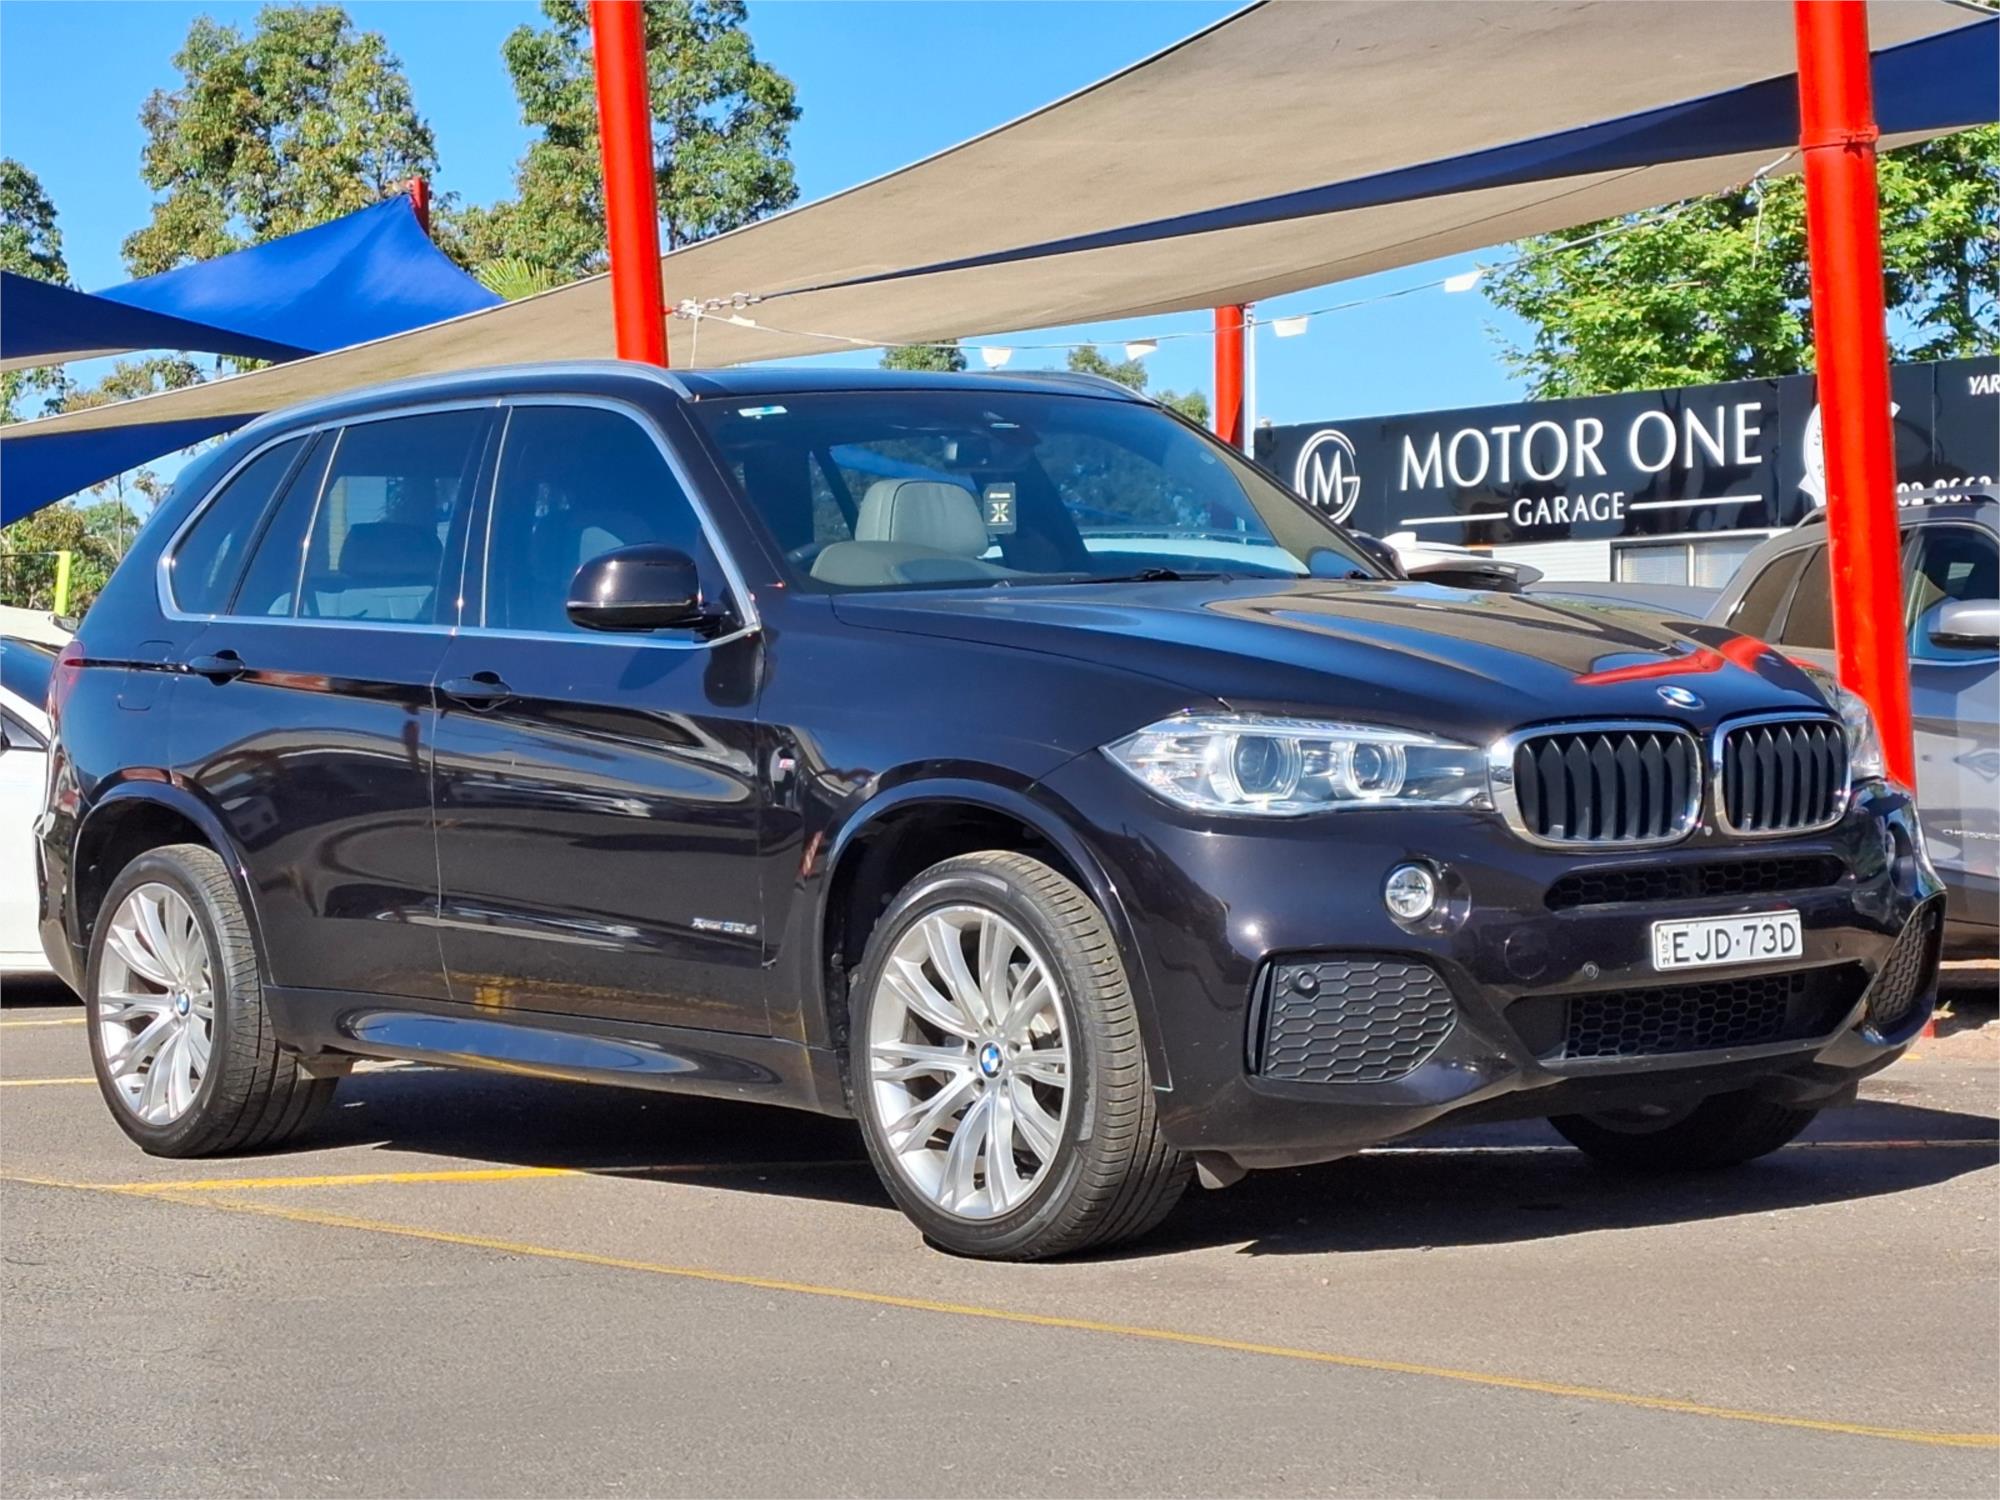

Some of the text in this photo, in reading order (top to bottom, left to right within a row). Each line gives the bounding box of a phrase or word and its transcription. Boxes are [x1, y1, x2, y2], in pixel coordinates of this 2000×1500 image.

[1400, 402, 1762, 491] MOTOR ONE
[1513, 492, 1625, 526] GARAGE
